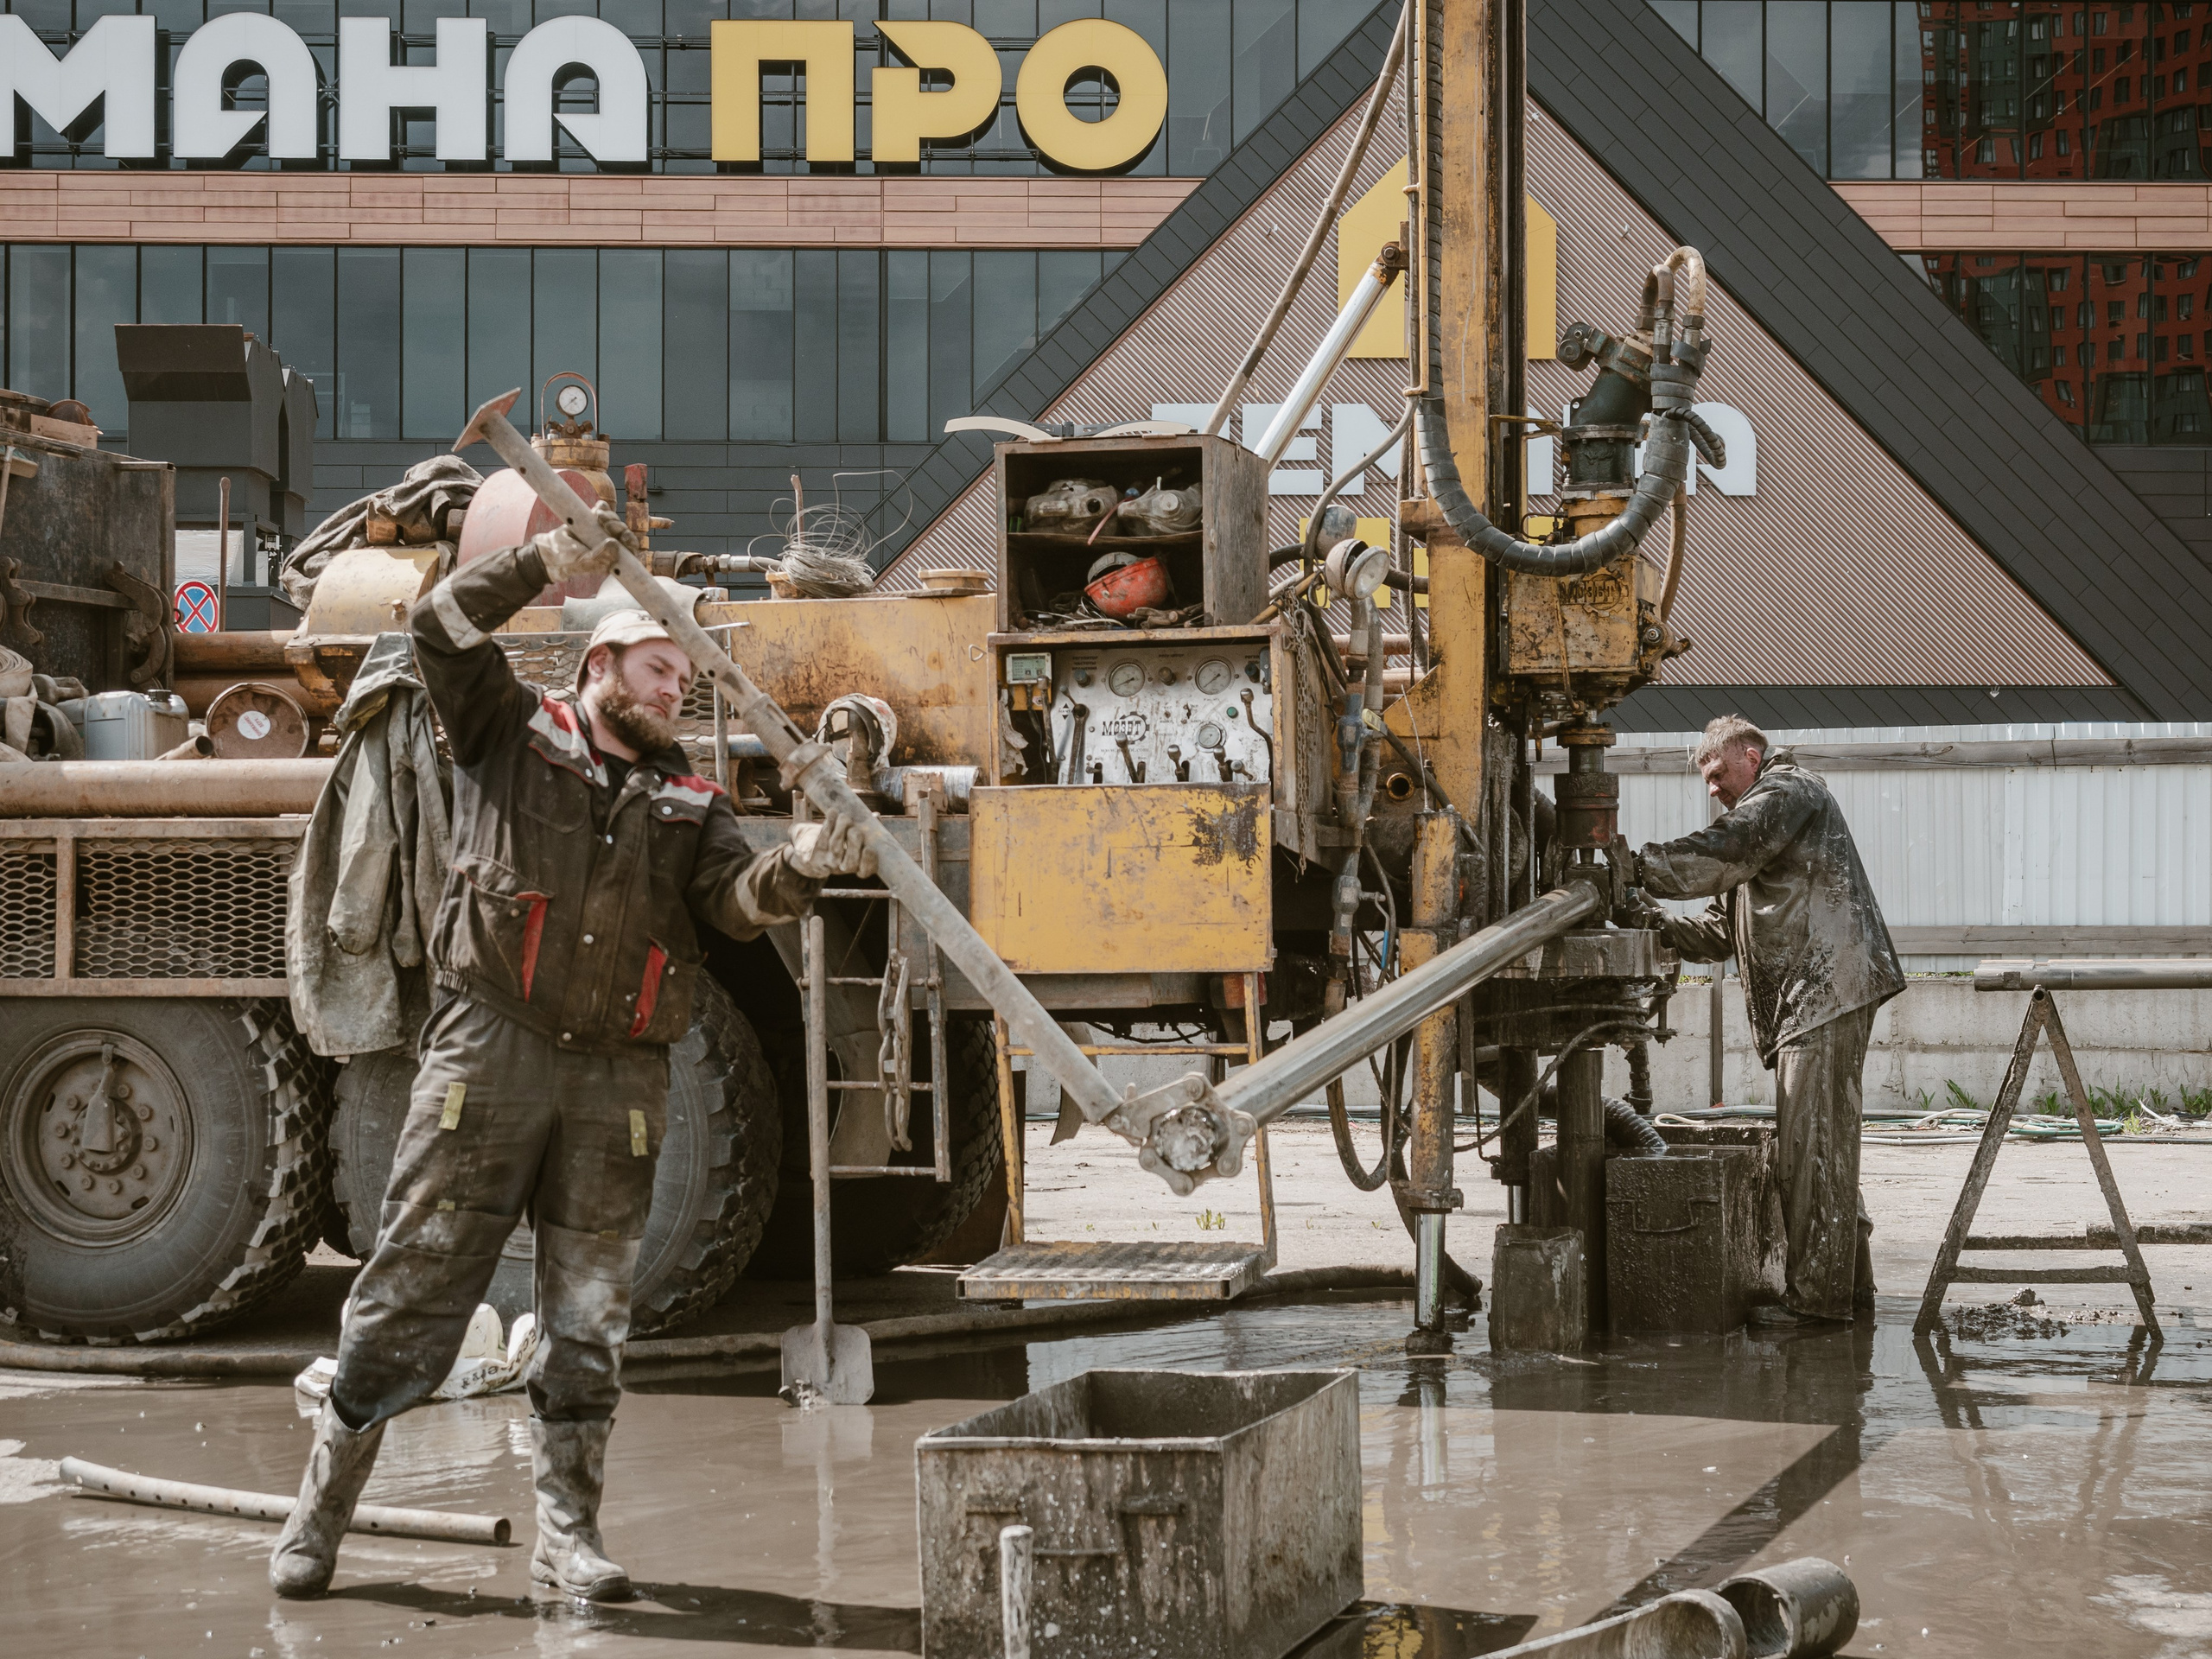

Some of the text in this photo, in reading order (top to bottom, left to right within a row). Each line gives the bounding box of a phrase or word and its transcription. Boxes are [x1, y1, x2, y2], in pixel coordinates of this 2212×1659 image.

[0, 12, 1168, 171] МАНА ПРО
[1102, 721, 1142, 735] МОЗБТ
